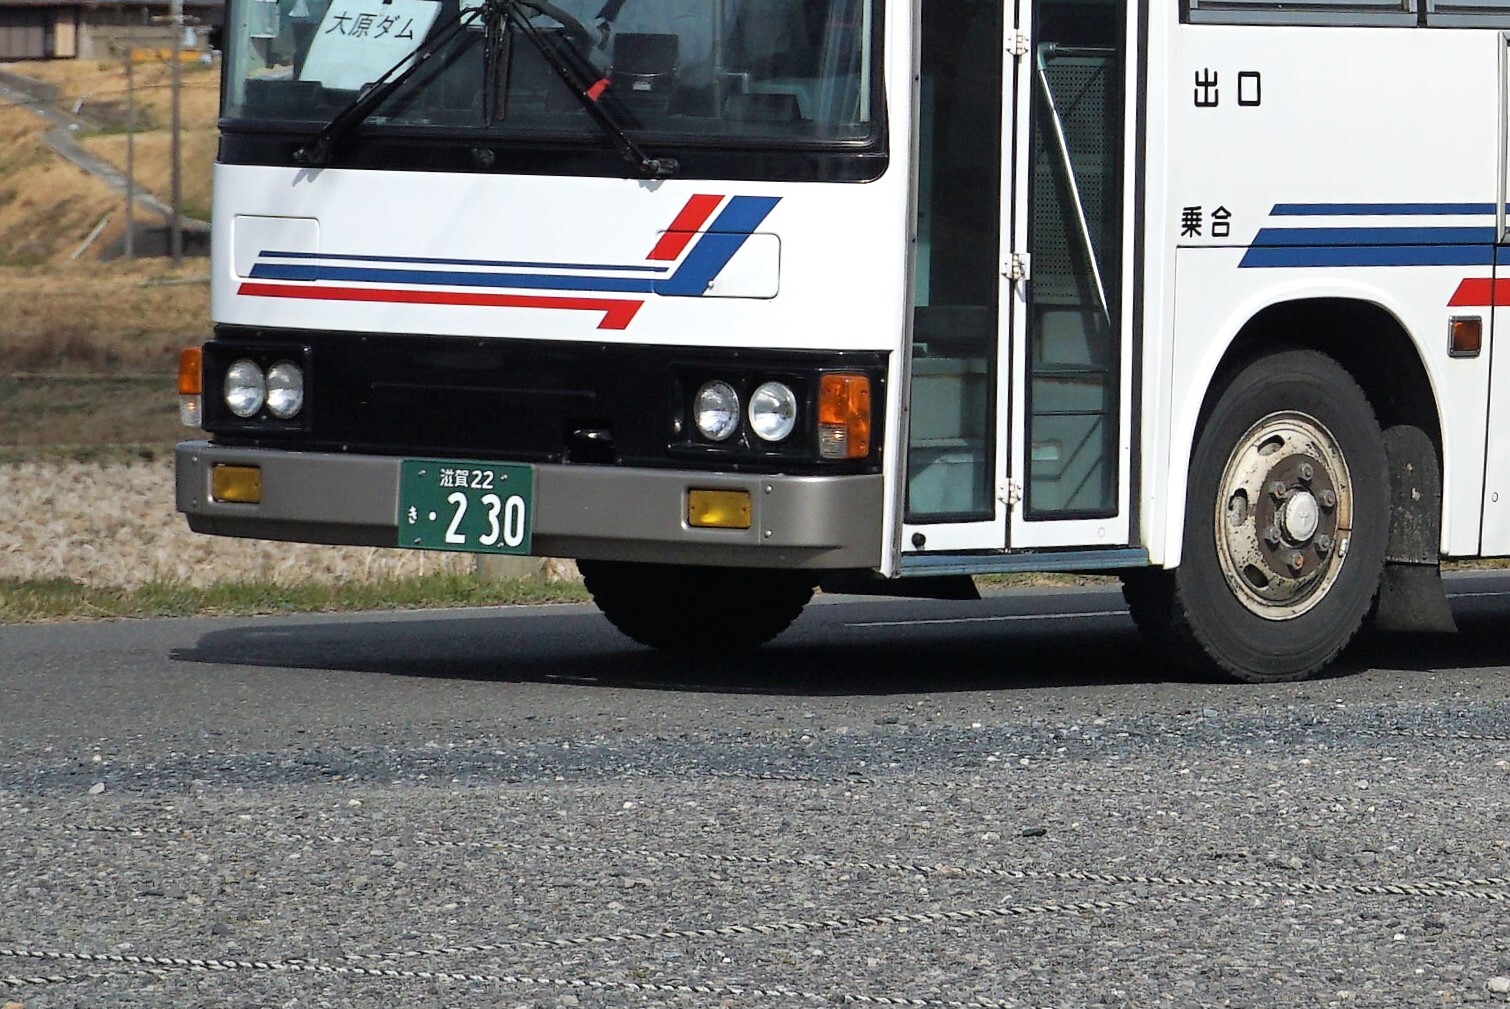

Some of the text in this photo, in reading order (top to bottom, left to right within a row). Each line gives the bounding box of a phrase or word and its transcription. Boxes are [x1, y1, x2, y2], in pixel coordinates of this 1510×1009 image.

[325, 11, 415, 40] 大原ダム
[1194, 67, 1261, 107] 出口
[1181, 205, 1232, 238] 乗合
